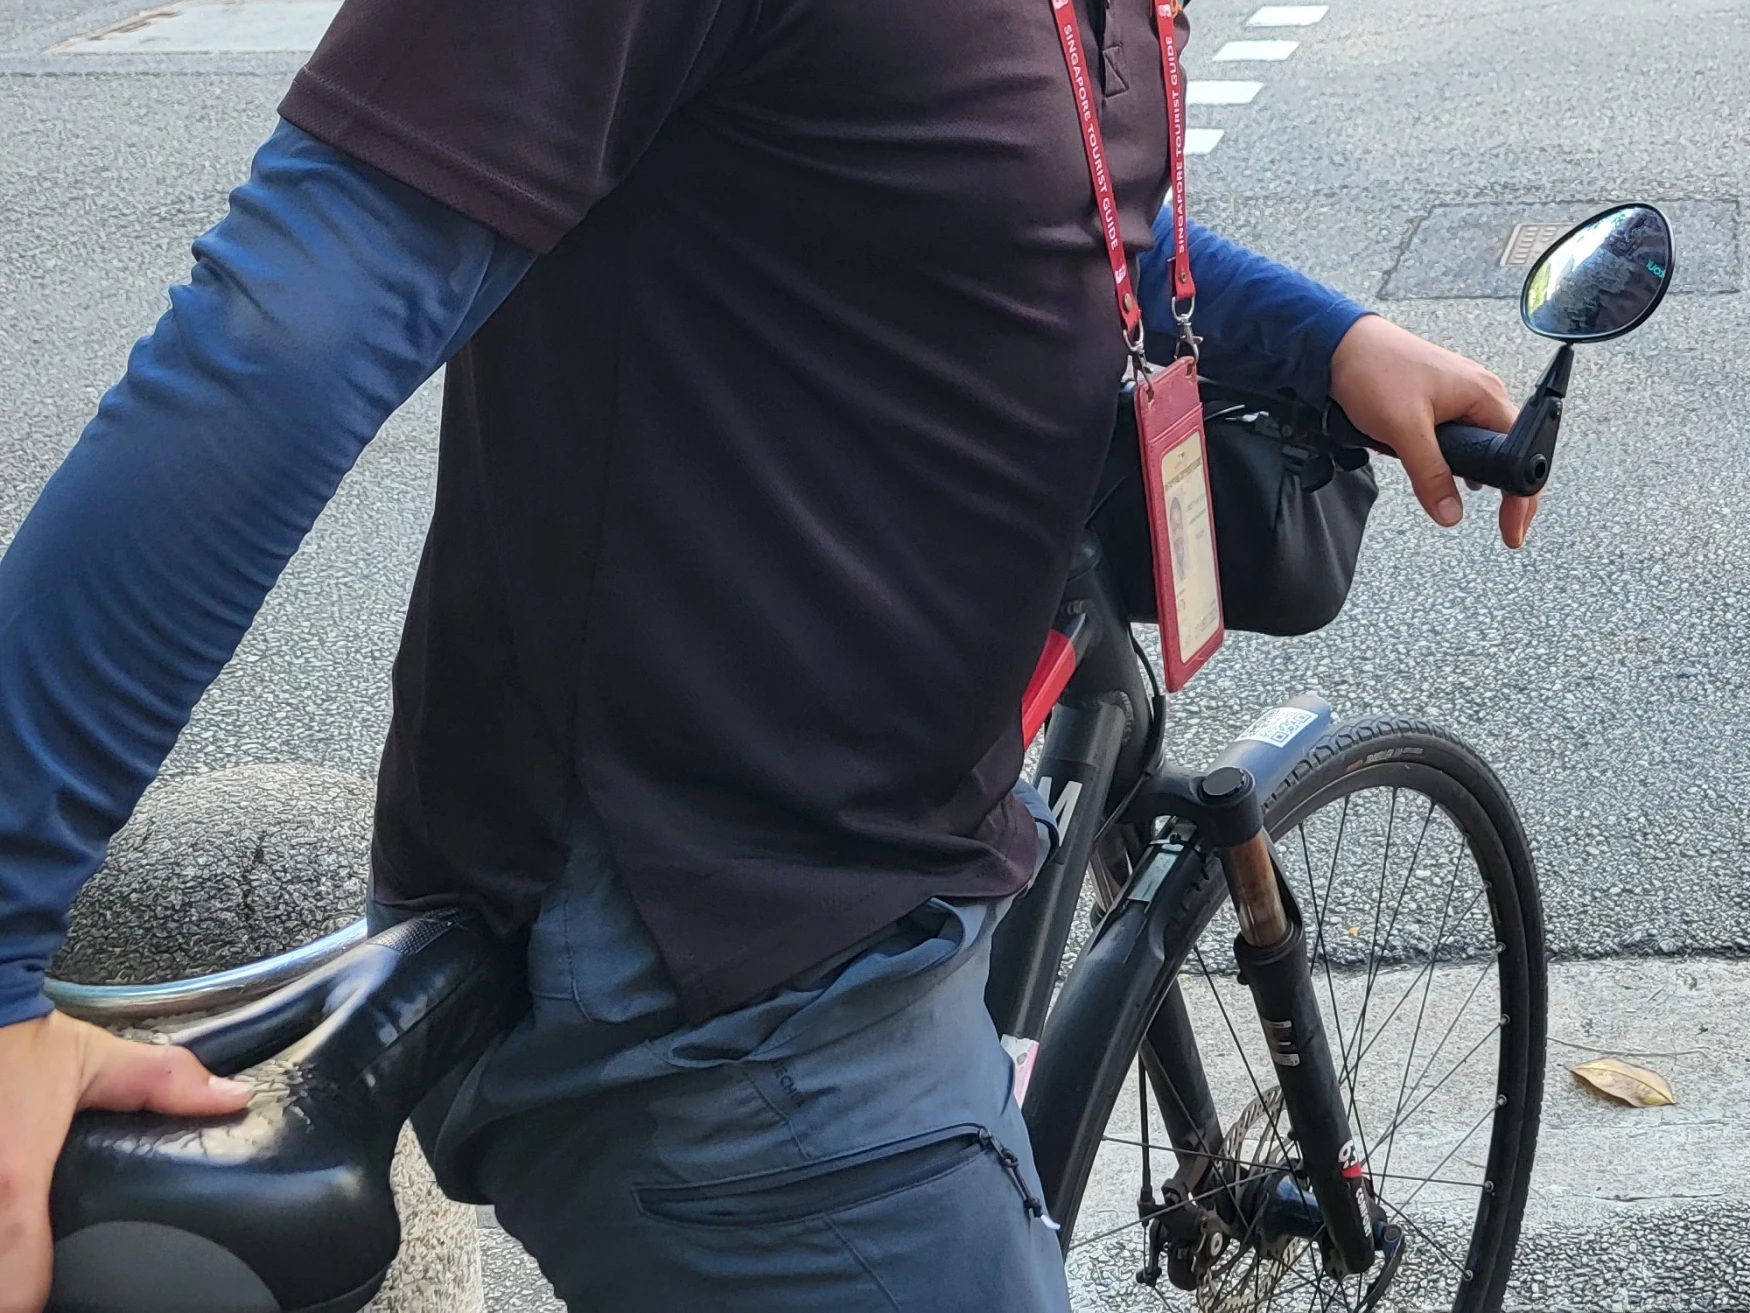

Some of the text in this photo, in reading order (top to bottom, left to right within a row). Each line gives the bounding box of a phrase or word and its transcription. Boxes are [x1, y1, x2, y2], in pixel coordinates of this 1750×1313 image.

[1064, 24, 1118, 251] SINGAPORE TOURIST GUIDE
[1165, 35, 1185, 254] SINGAPORE TOURIST GUIDE
